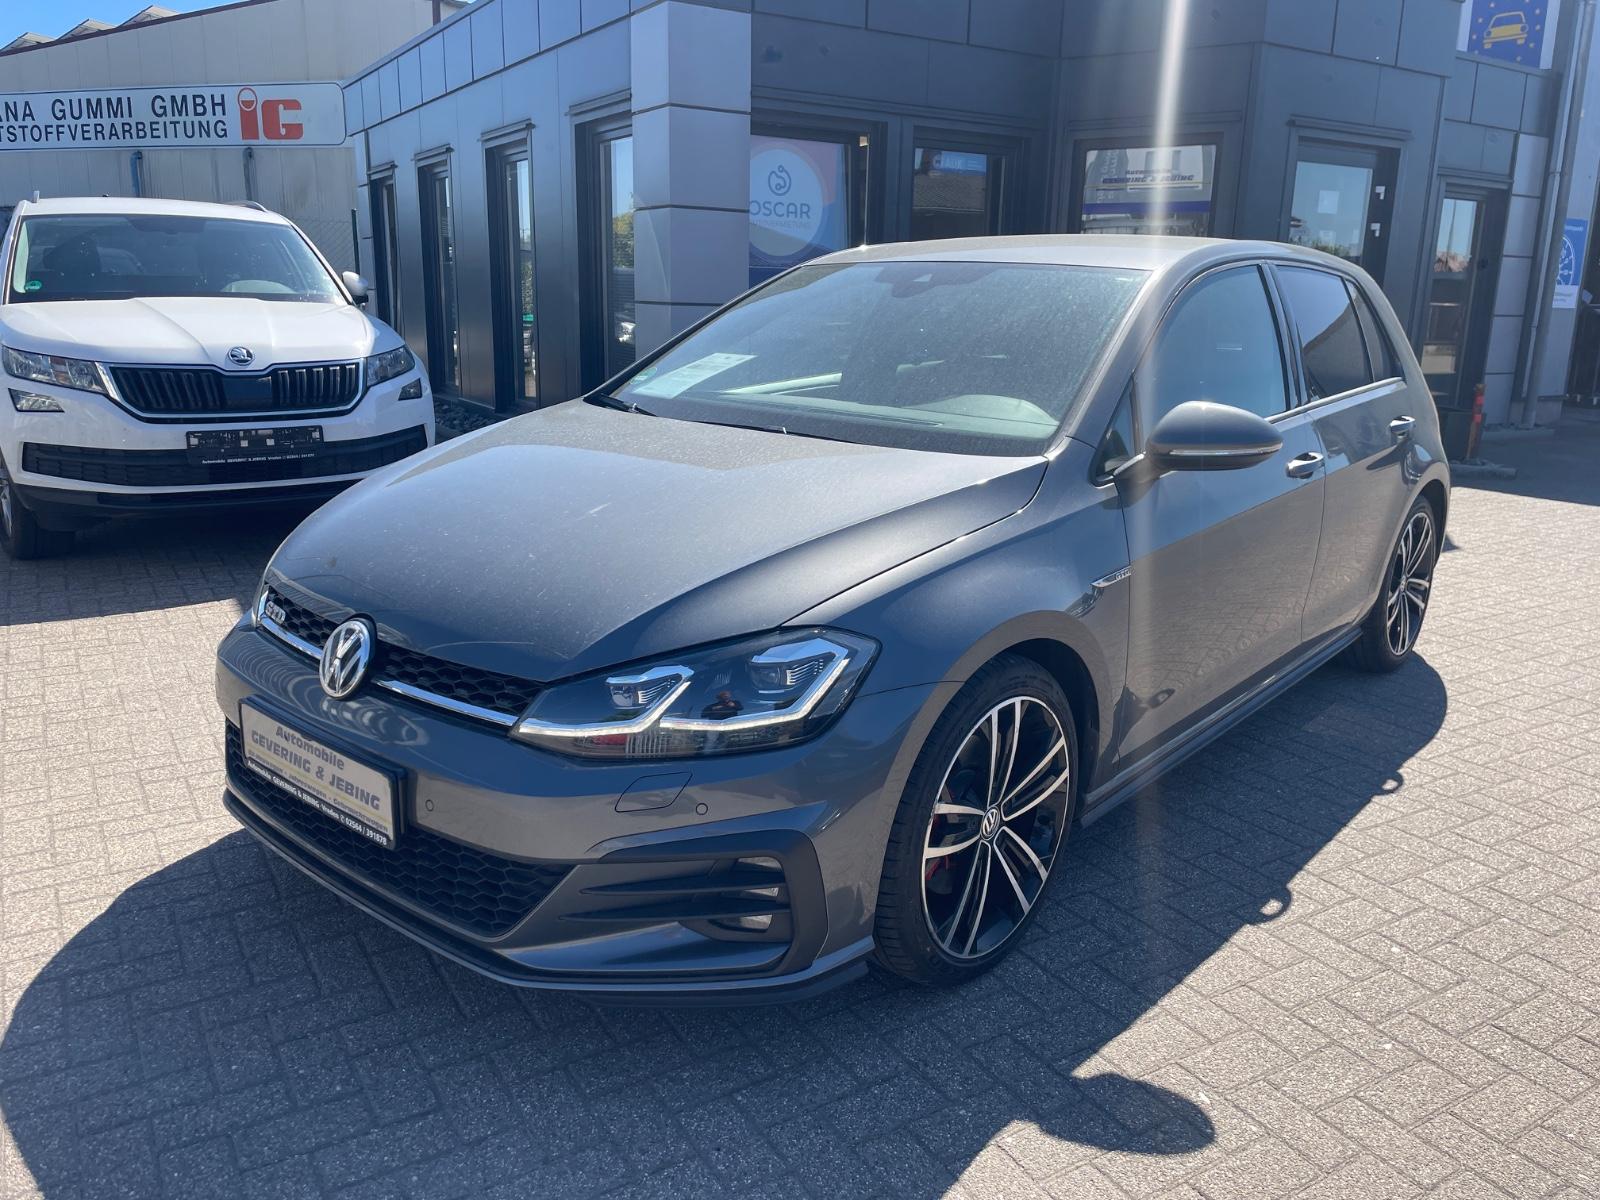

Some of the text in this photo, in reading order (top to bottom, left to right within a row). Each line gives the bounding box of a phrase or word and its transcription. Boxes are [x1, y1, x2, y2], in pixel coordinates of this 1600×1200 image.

[0, 94, 227, 123] NA GUMMI GMBH
[750, 200, 811, 219] OSCAR
[275, 726, 344, 770] Automobile
[251, 730, 311, 773] GEVERING
[315, 765, 325, 782] &
[329, 773, 380, 811] JEBING
